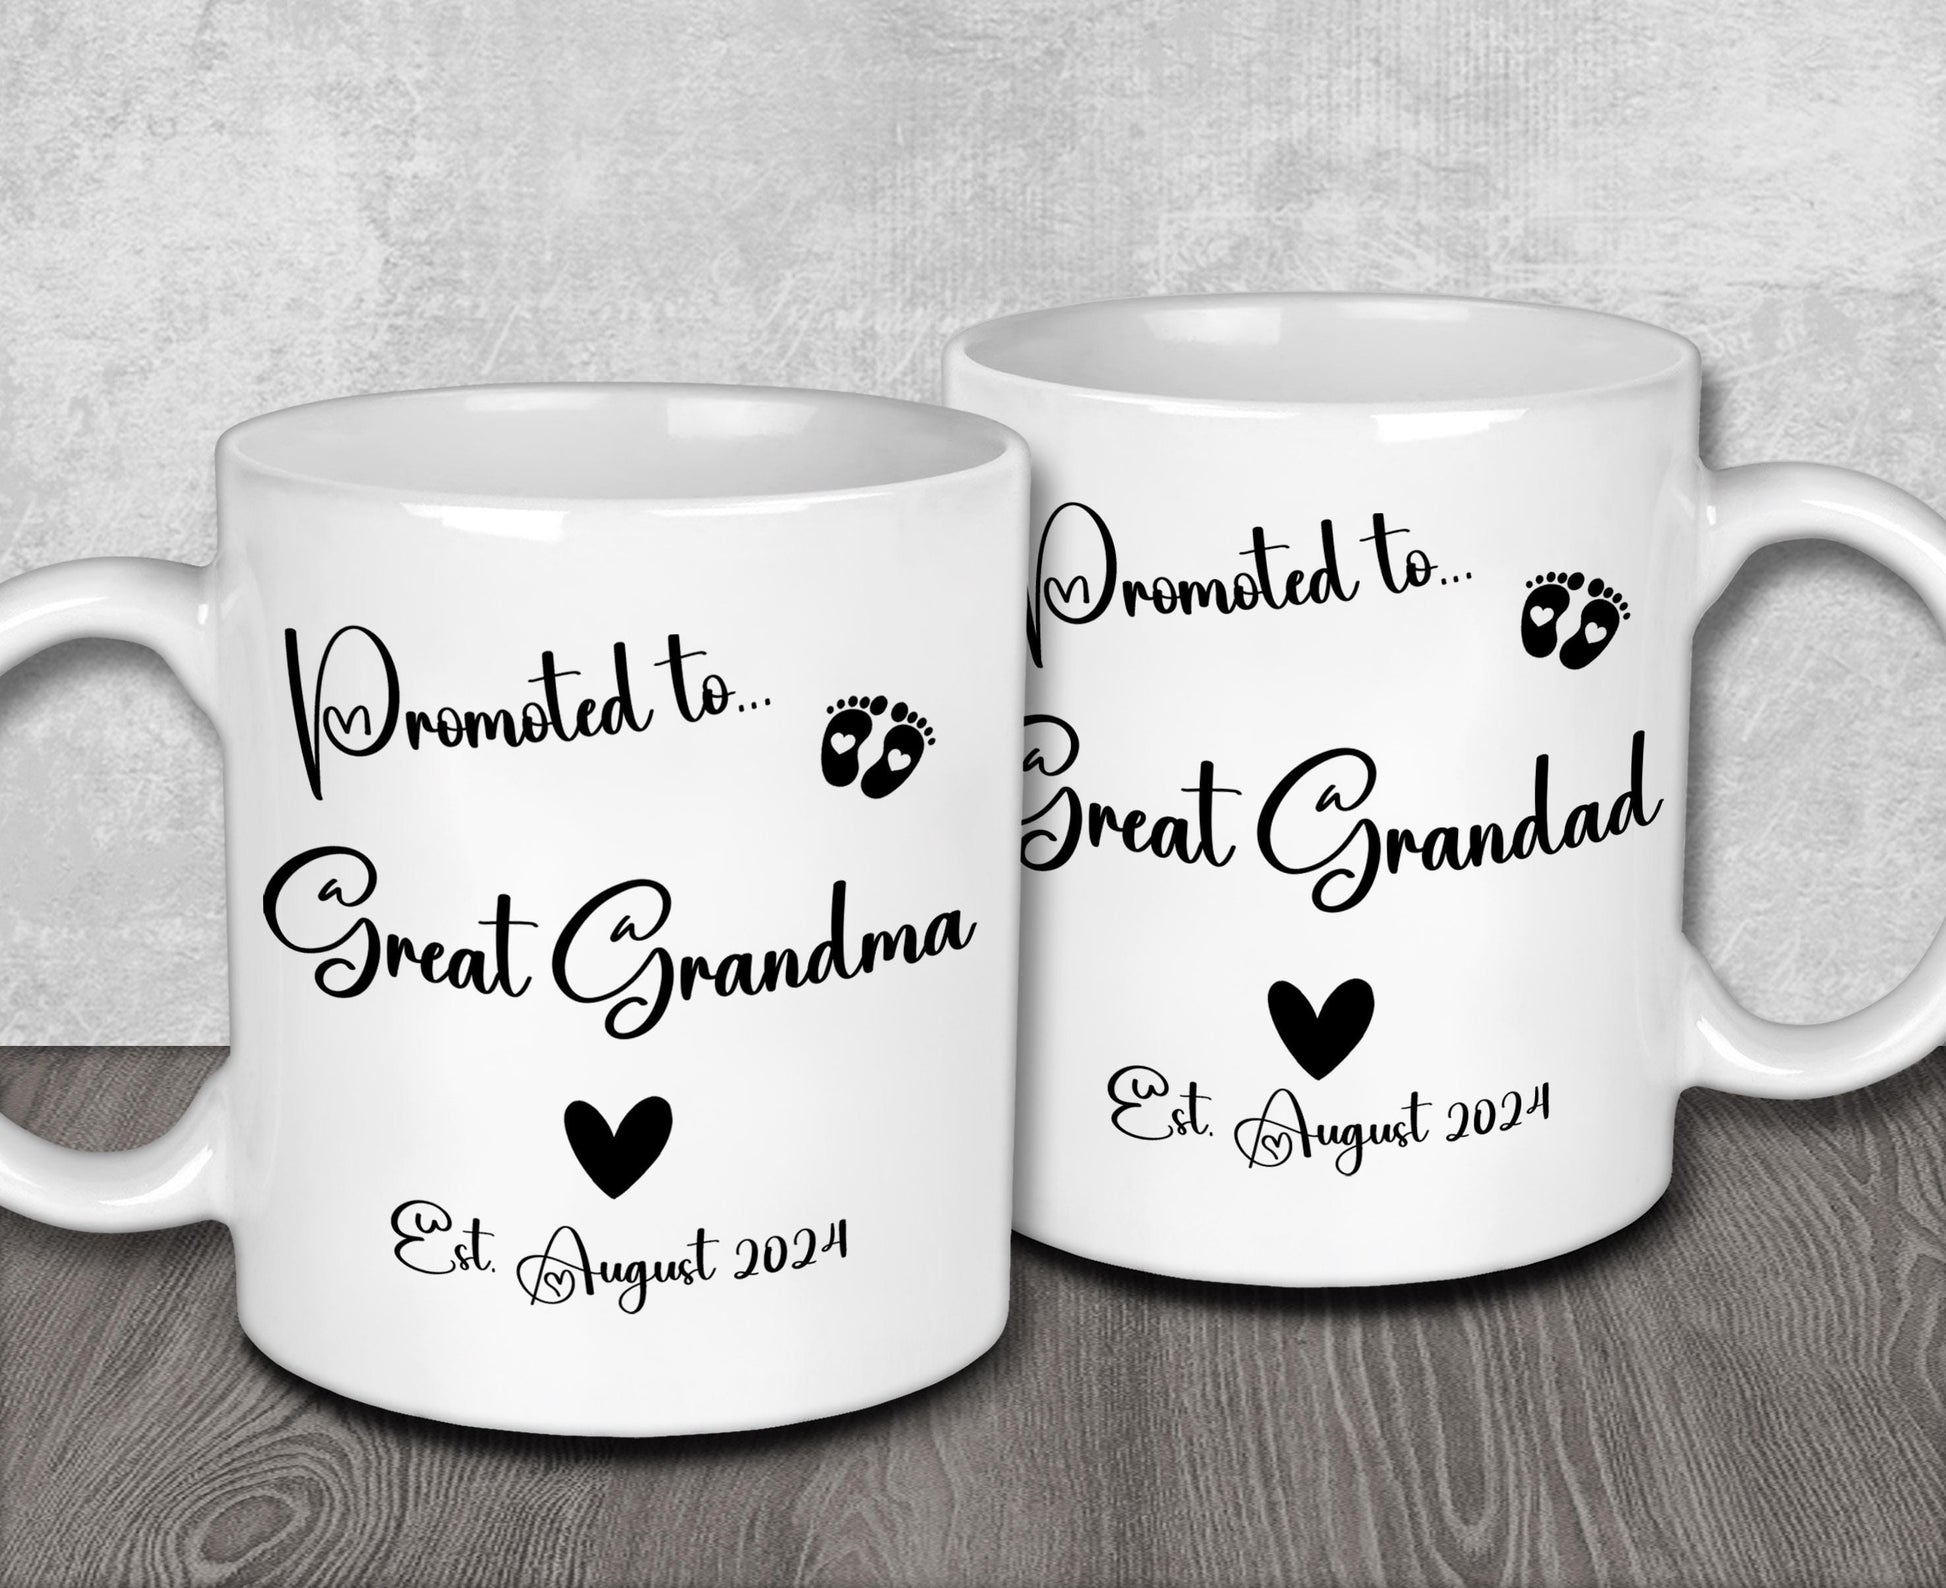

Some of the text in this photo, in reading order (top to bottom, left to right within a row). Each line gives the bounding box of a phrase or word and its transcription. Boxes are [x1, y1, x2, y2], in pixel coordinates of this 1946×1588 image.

[1026, 502, 1359, 669] Promoted
[285, 624, 654, 801] Promoted
[1257, 730, 1665, 914] Grandad
[263, 846, 978, 1040] Great Grandma
[1107, 1065, 1550, 1177] Est. August 2024
[390, 1199, 848, 1314] Est. August 2024
